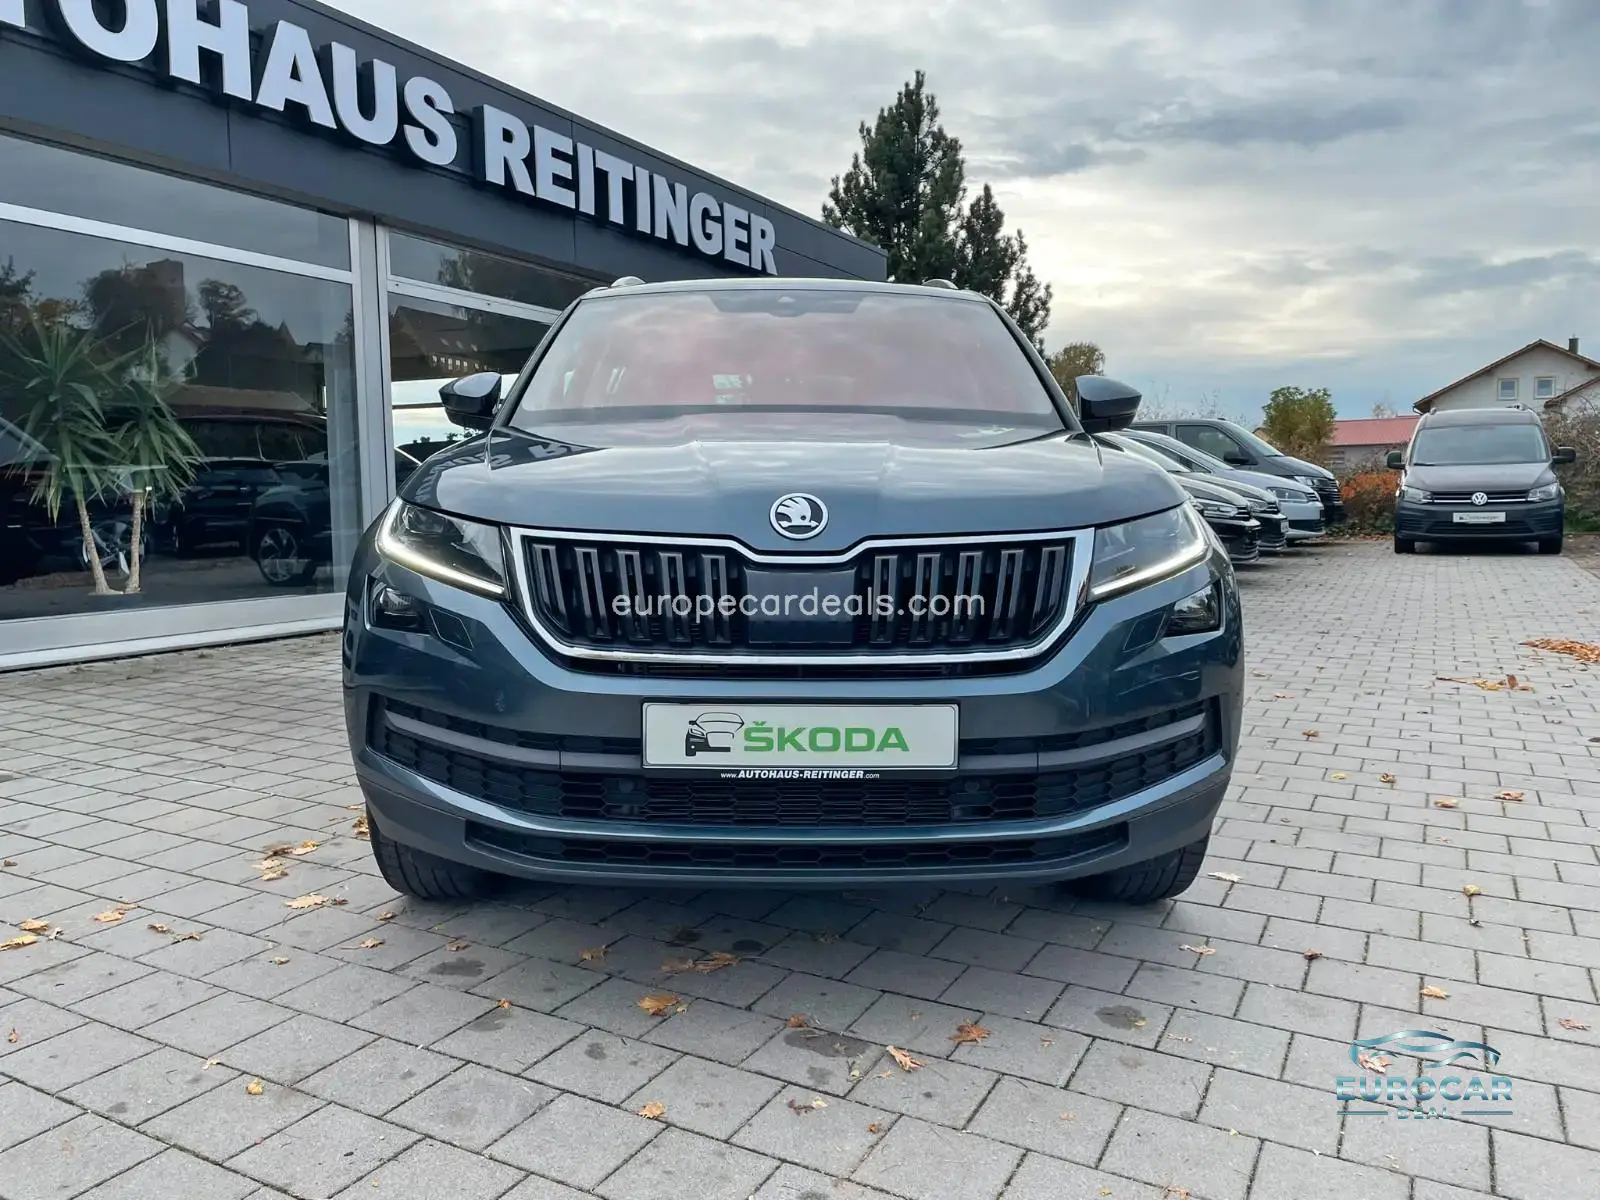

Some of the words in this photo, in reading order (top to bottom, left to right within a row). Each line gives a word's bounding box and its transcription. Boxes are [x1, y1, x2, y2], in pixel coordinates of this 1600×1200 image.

[0, 0, 458, 165] OHAUS
[483, 104, 777, 275] REITINGER
[743, 721, 910, 752] ŠKODA
[720, 770, 880, 779] www.AUTOHAUS-REITINGER.com
